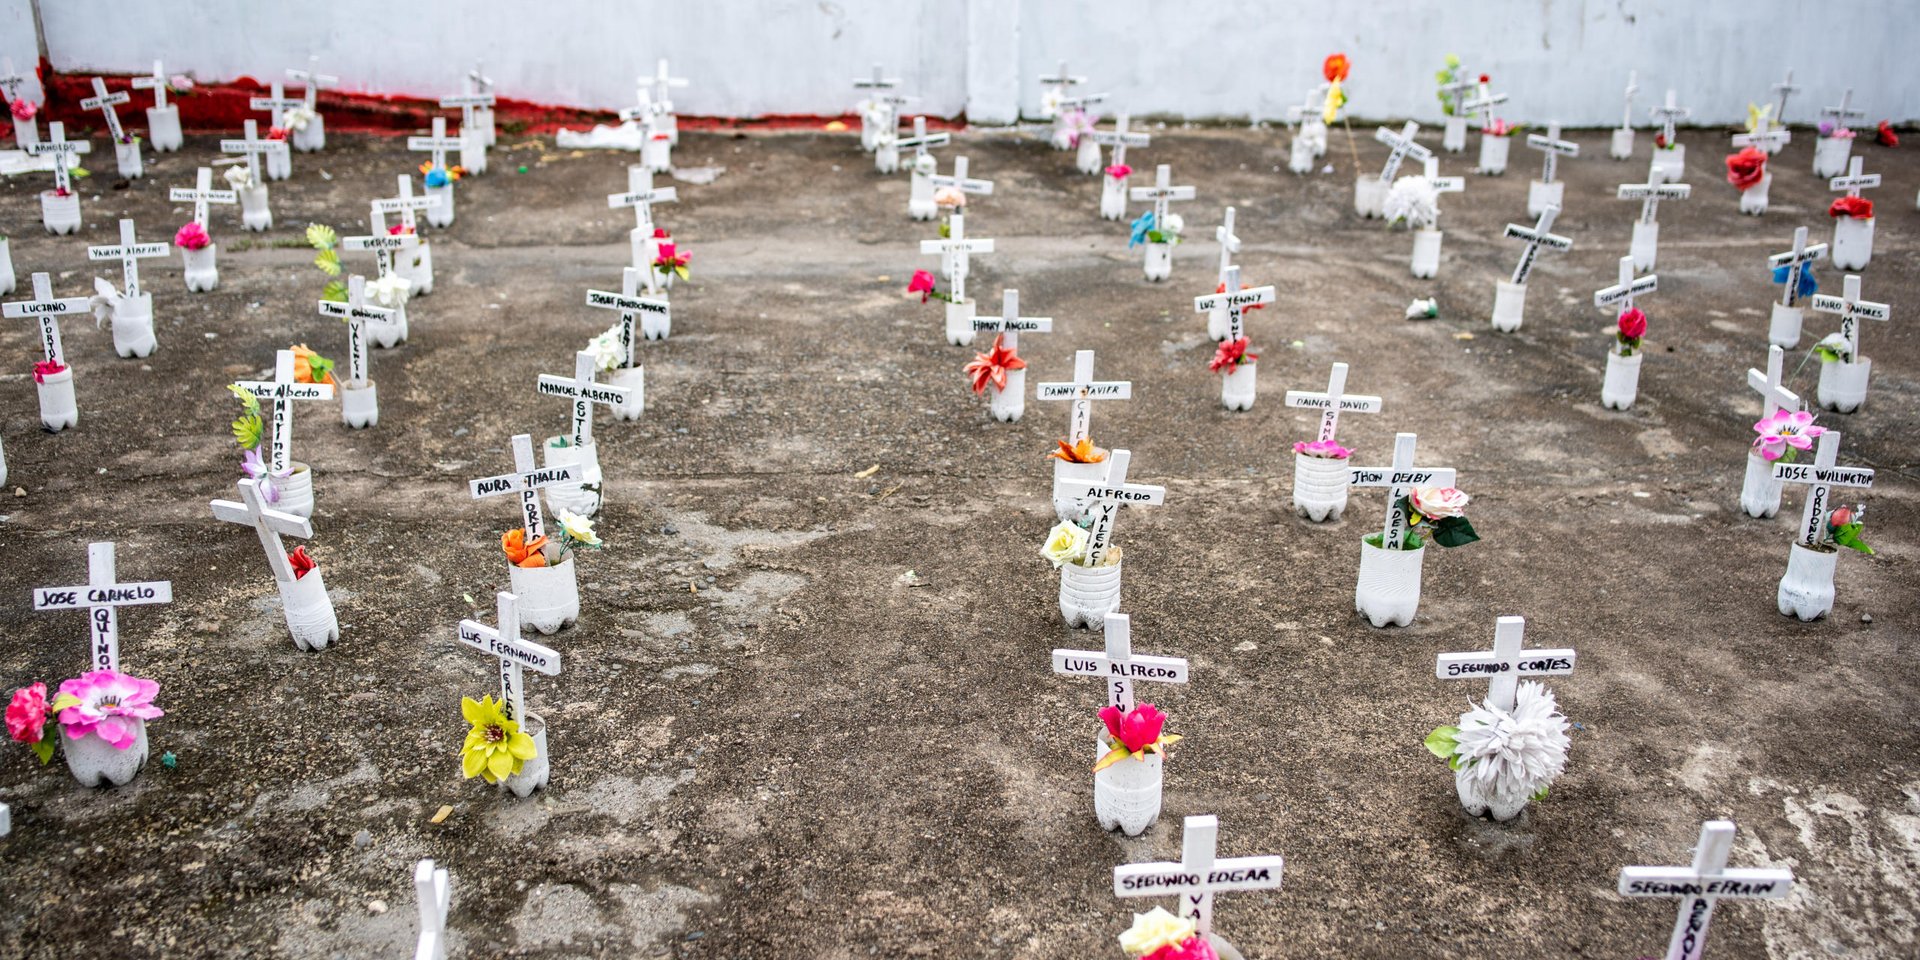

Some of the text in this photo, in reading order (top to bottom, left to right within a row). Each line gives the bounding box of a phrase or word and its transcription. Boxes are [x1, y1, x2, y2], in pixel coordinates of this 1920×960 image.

[22, 302, 66, 313] LUCIANO
[1200, 300, 1215, 310] LUZ
[275, 384, 320, 398] Alberto
[540, 382, 623, 404] MANUEL ALBERTO
[1044, 386, 1075, 396] DANNY
[1340, 401, 1369, 411] DAVID
[1351, 471, 1382, 484] JHON
[1775, 466, 1808, 479] JOSE
[477, 470, 570, 495] AURA THALIA
[1087, 488, 1150, 500] ALFREDO
[39, 586, 155, 607] JOSE CARMELO
[94, 609, 111, 669] QUINO
[461, 627, 546, 667] LUIS FERNANDO
[1065, 658, 1176, 678] LUIS ALFREDO
[1448, 659, 1571, 676] SEGUNDO CORTES
[1122, 869, 1270, 889] SEGUNDO EDGAR
[1629, 881, 1703, 895] SEGUNDO
